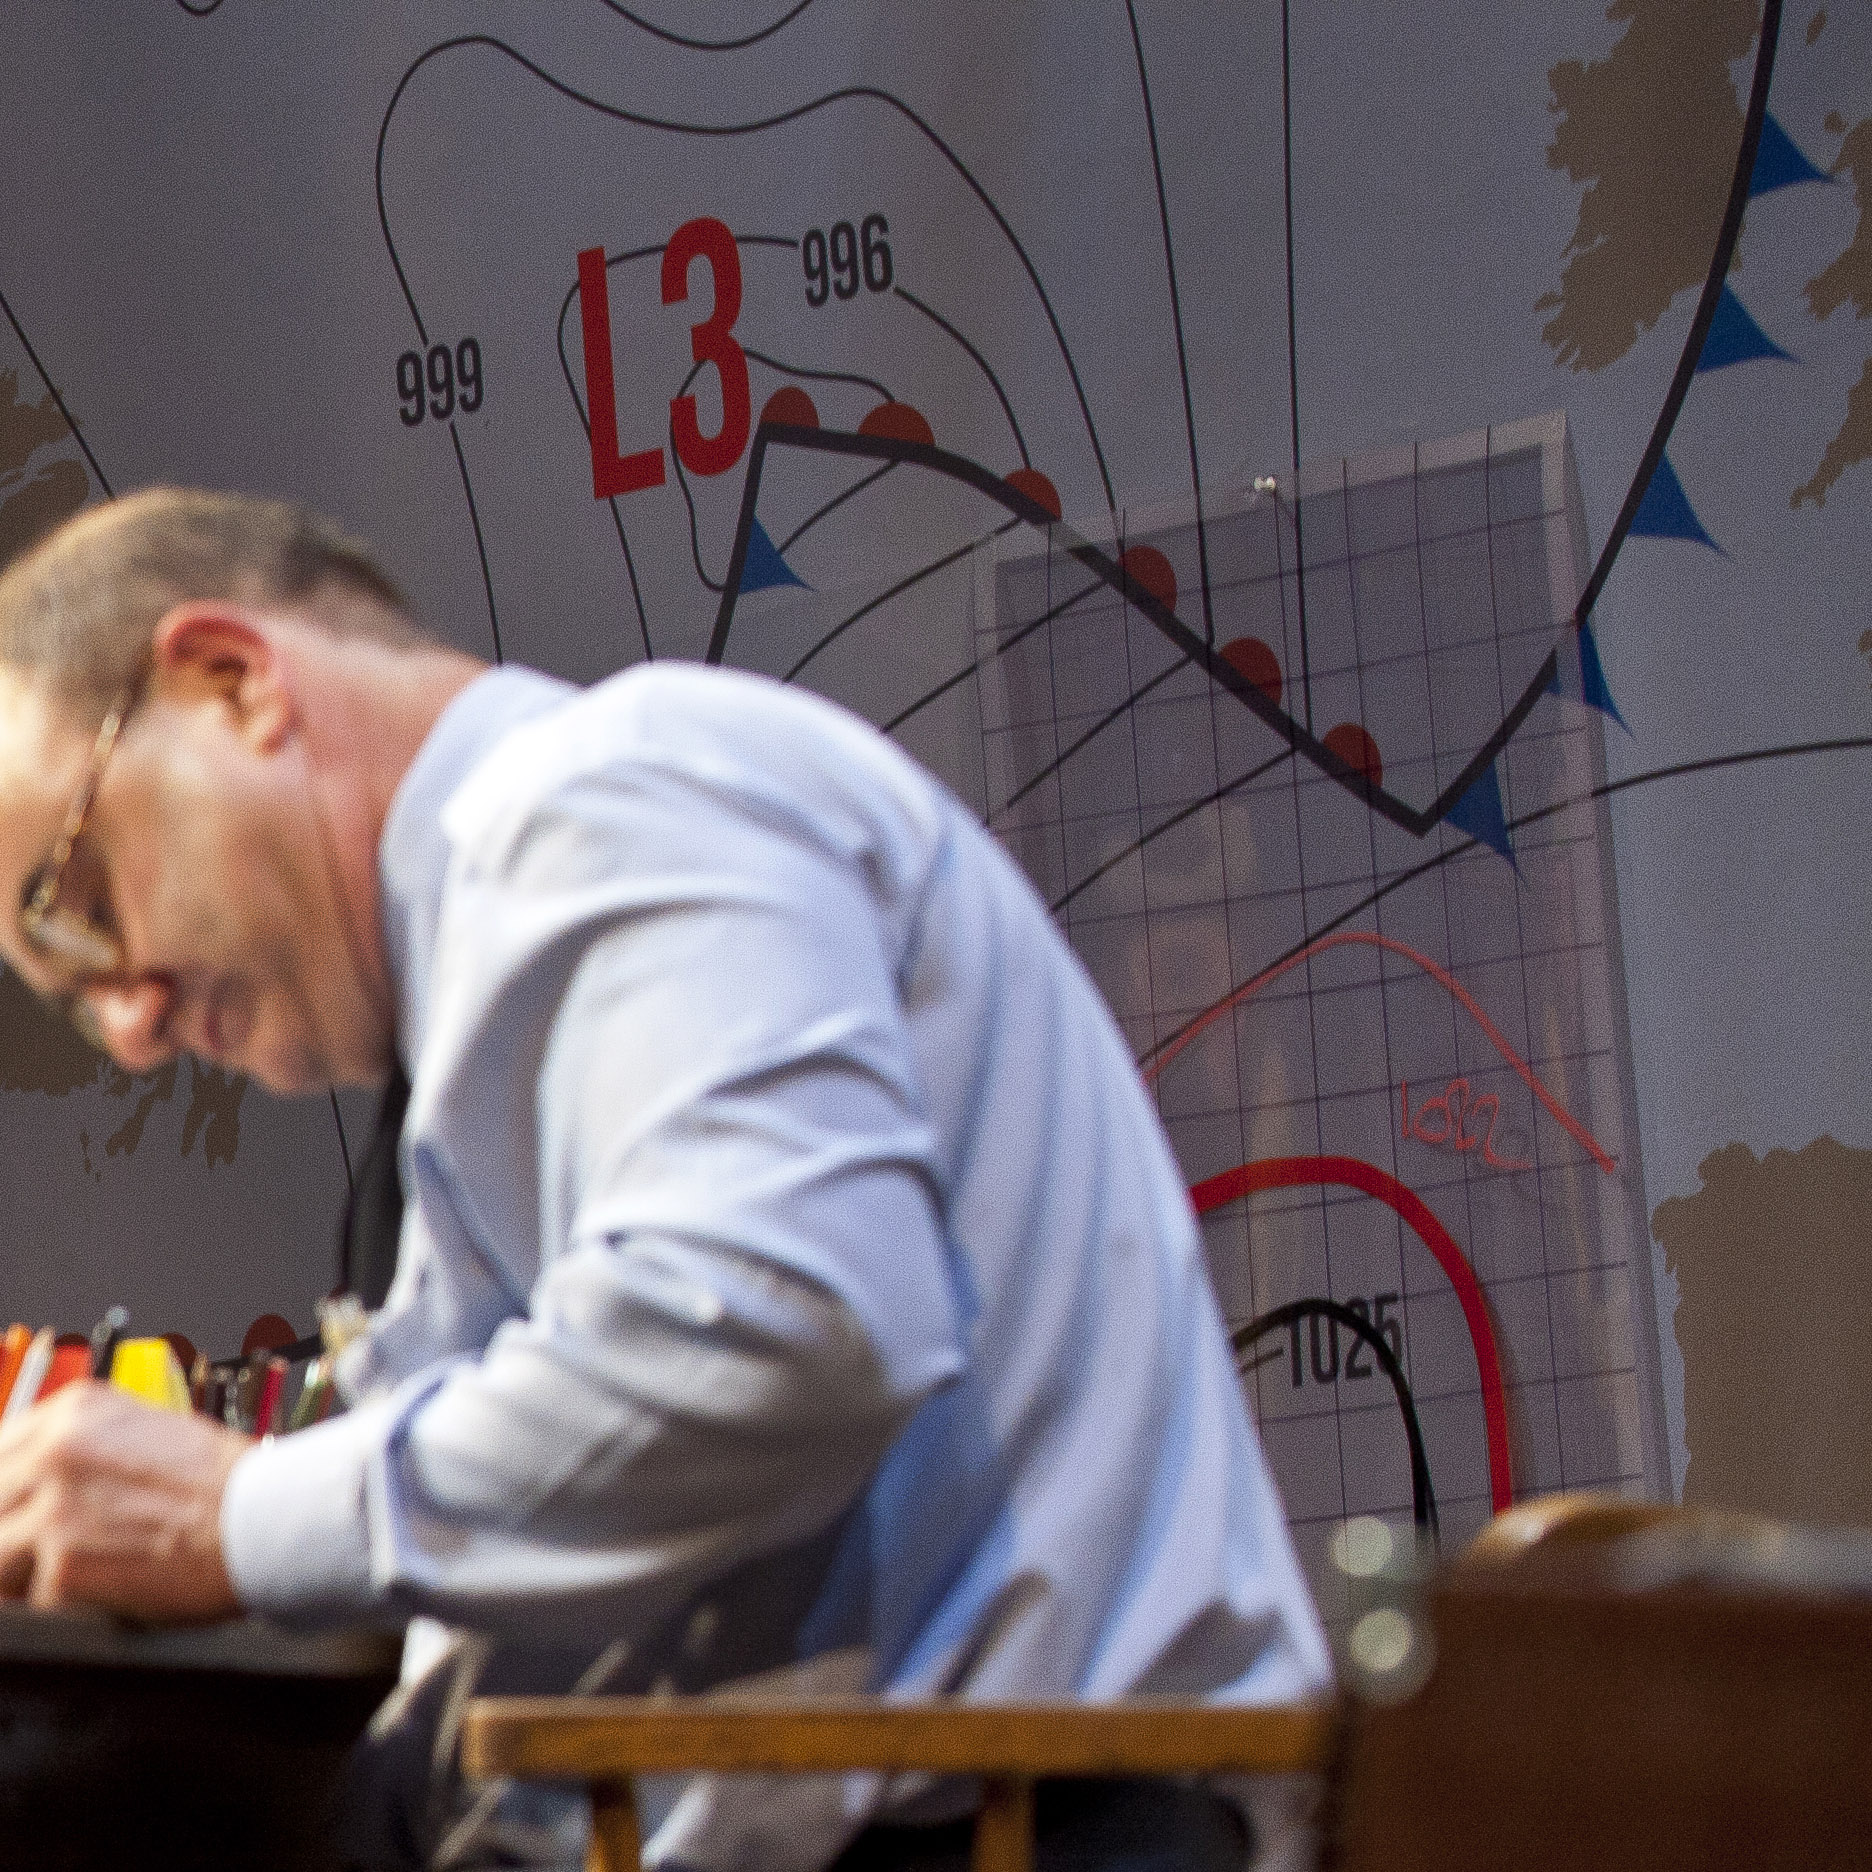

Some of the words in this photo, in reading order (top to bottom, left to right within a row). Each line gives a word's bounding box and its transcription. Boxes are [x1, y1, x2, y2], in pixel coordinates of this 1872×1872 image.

[802, 214, 894, 307] 996
[396, 337, 485, 428] 999
[577, 217, 749, 500] L3
